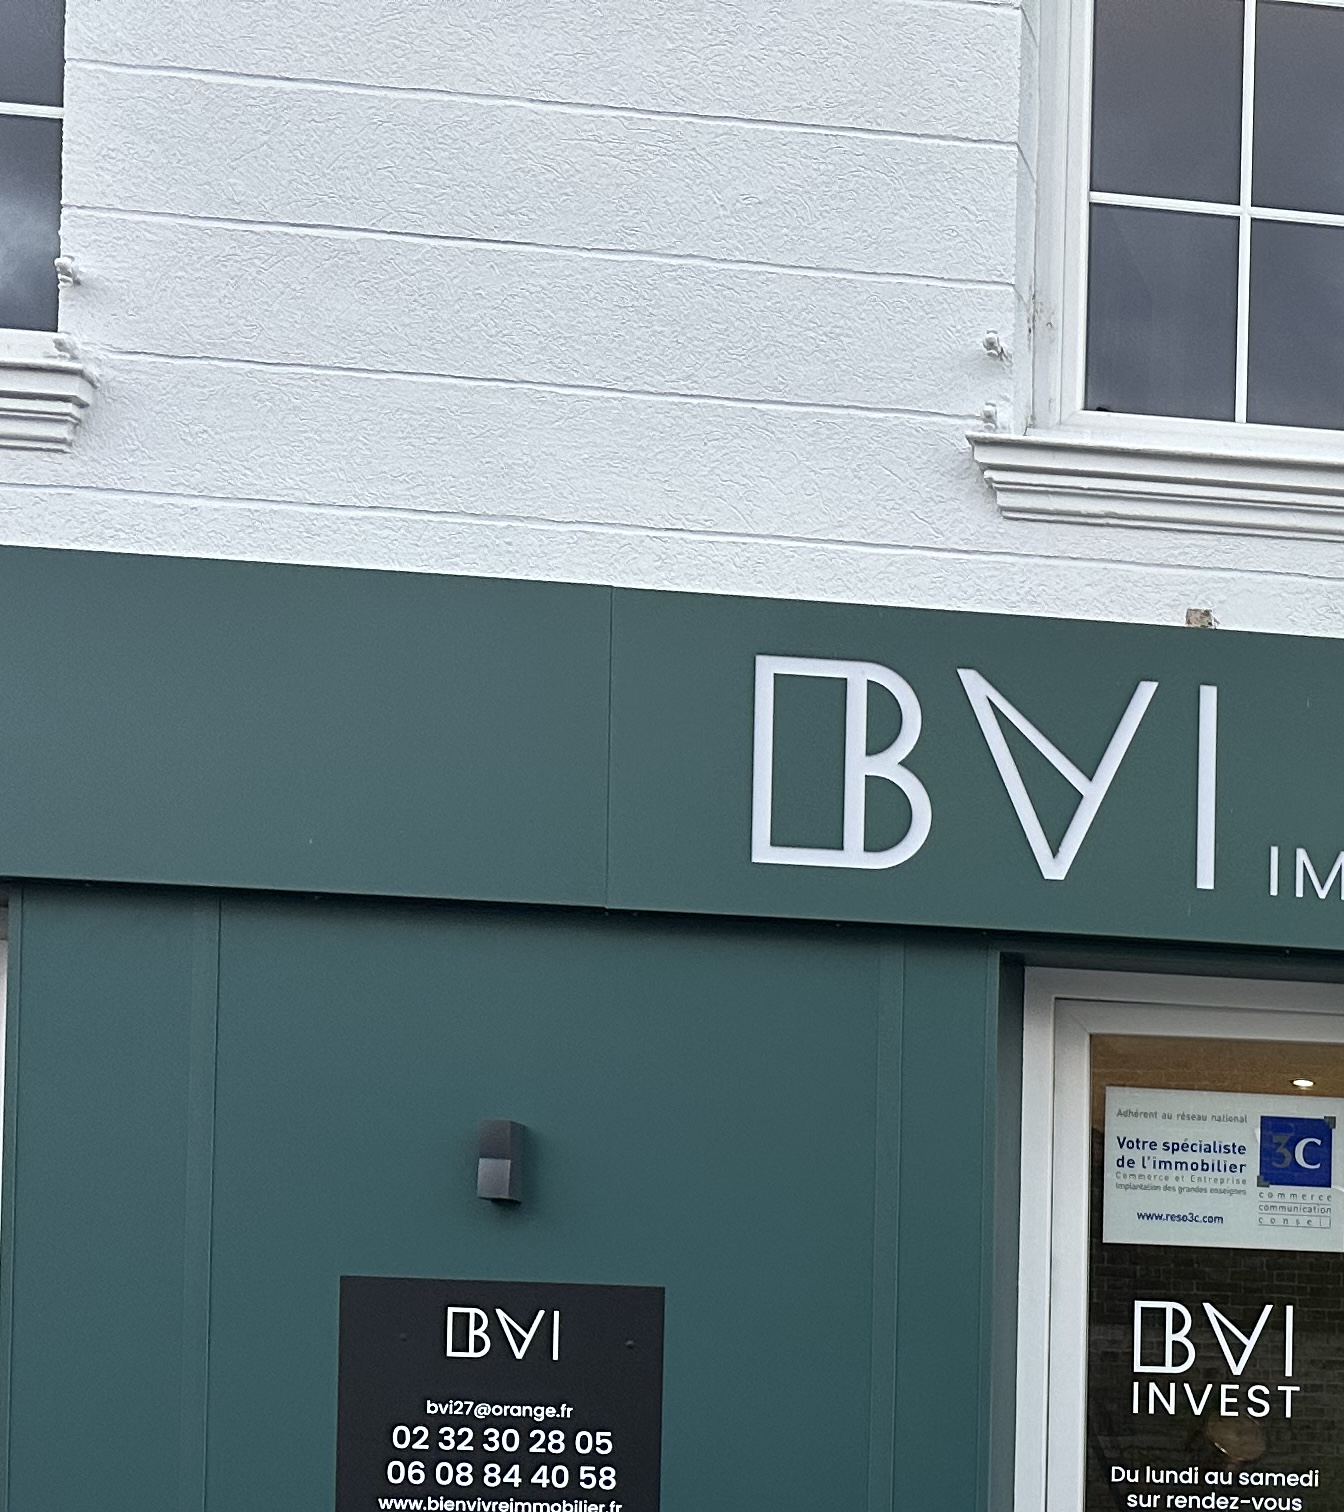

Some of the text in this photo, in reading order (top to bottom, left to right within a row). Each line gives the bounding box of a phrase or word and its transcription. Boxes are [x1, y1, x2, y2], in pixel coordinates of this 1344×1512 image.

[752, 655, 1217, 889] BVI
[1116, 1108, 1248, 1123] Adhérent au réseau national
[1116, 1135, 1247, 1155] Votre spécialiste
[1272, 1135, 1321, 1170] 3C
[1116, 1155, 1247, 1174] de l'immobilier
[1115, 1171, 1247, 1186] Commerce et Entreprise
[1258, 1191, 1332, 1202] commerce
[1136, 1210, 1224, 1225] www.reso3c.com
[1258, 1203, 1332, 1214] communication
[1258, 1216, 1332, 1228] conseil
[447, 1307, 559, 1360] BVI
[1134, 1300, 1293, 1376] BVI
[1133, 1382, 1300, 1418] INVEST
[427, 1400, 573, 1421] bvi27@orange.fr
[393, 1426, 612, 1454] 02 32 30 28 05
[387, 1461, 616, 1490] 06 08 84 40 58
[1111, 1466, 1319, 1487] Du lundi au samedi
[1127, 1492, 1302, 1511] sur rendez-vous
